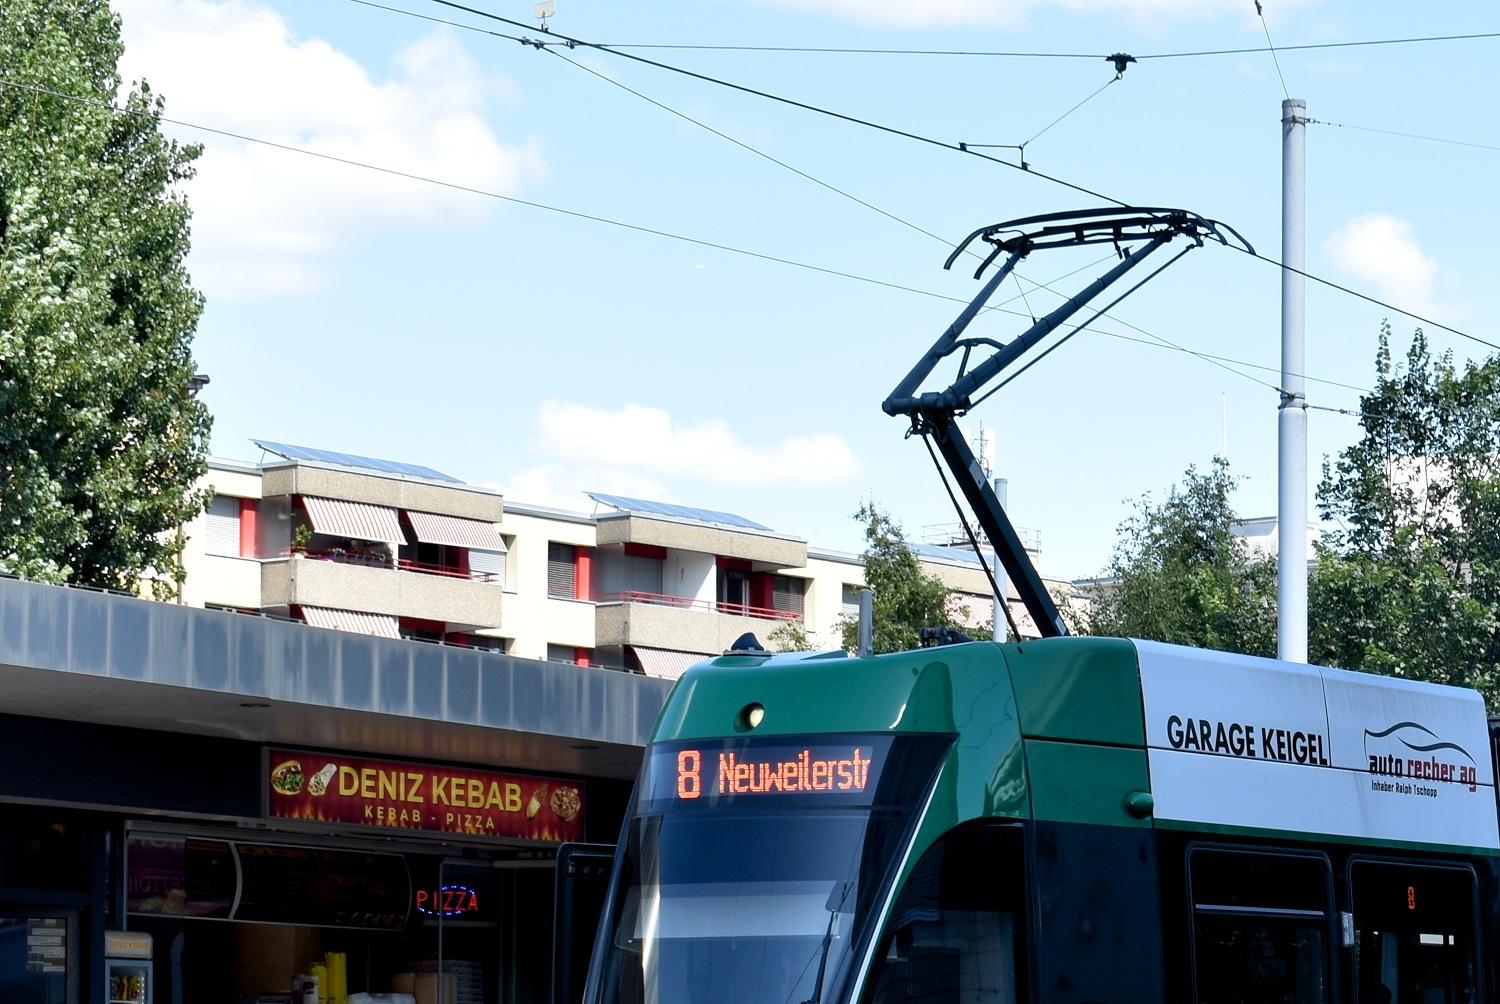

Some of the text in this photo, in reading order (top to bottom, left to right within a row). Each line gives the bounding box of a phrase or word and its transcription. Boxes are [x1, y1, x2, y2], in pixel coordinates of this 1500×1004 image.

[1167, 715, 1328, 766] GARAGE KEIGEL
[678, 748, 871, 799] 8 Neuweilerstr
[1369, 754, 1477, 792] auto recher ag
[339, 766, 522, 812] DENIZ KEBAB
[1371, 780, 1438, 798] Inhaber Ralph Tschopp
[365, 804, 421, 822] KEBAB
[446, 813, 495, 829] PIZZA
[416, 890, 479, 912] PIZZA
[1407, 886, 1415, 910] 8
